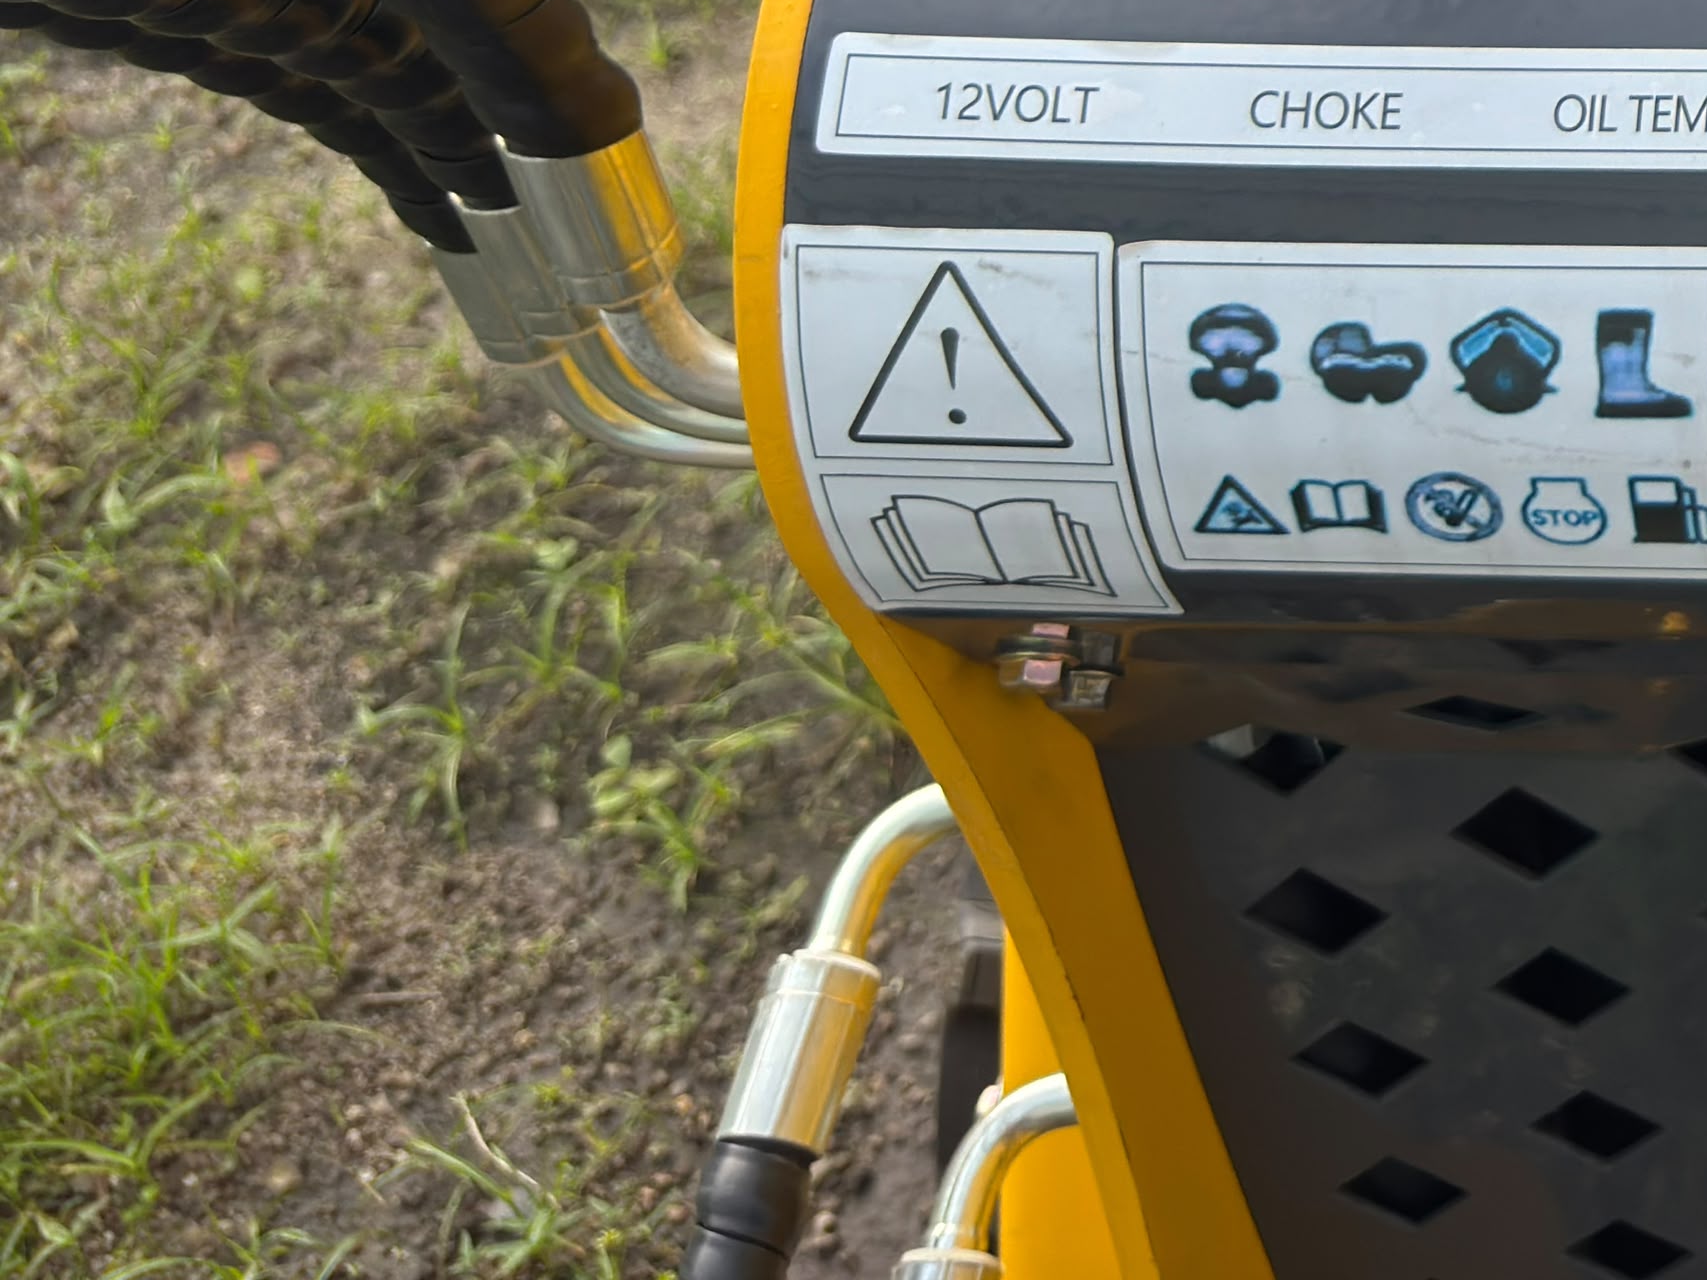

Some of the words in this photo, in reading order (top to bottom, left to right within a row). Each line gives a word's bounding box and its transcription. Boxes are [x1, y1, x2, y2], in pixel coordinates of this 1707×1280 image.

[936, 82, 1100, 124] 12VOLT
[1249, 90, 1404, 131] CHOKE
[1553, 93, 1618, 133] OIL
[1532, 508, 1597, 526] STOP
